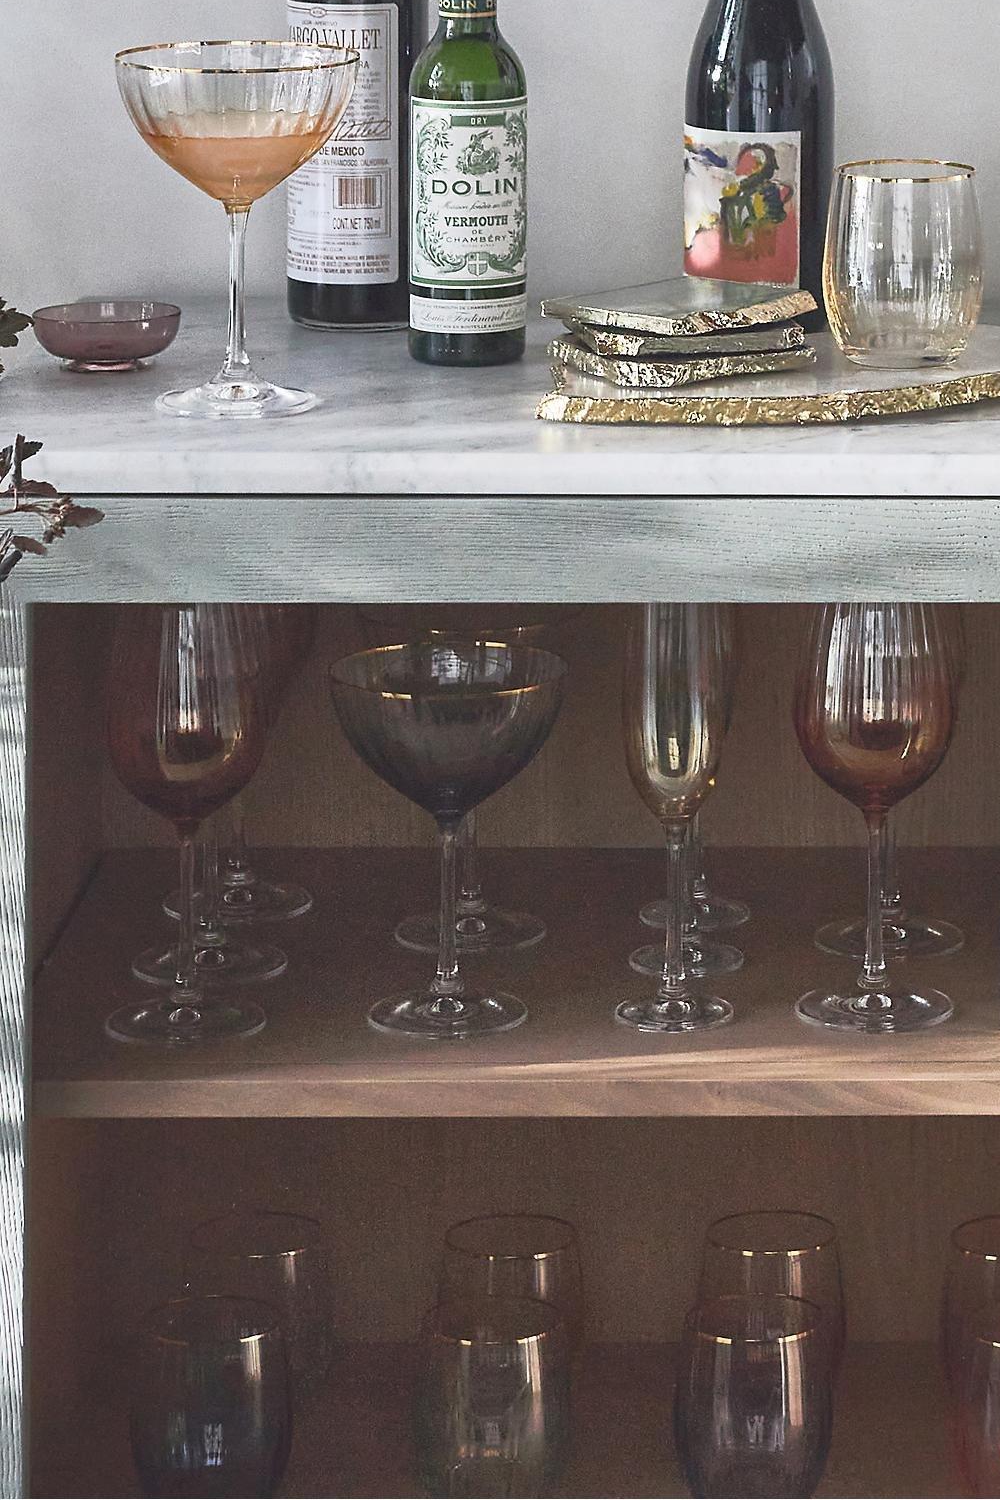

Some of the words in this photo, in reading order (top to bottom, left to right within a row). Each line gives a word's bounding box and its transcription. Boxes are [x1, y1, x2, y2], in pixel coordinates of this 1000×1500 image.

[470, 117, 488, 126] DRY
[331, 146, 366, 157] MEXICO
[431, 176, 518, 196] DOLIN
[443, 214, 509, 228] VERMOUTH
[445, 234, 507, 244] CHAMBÉRY
